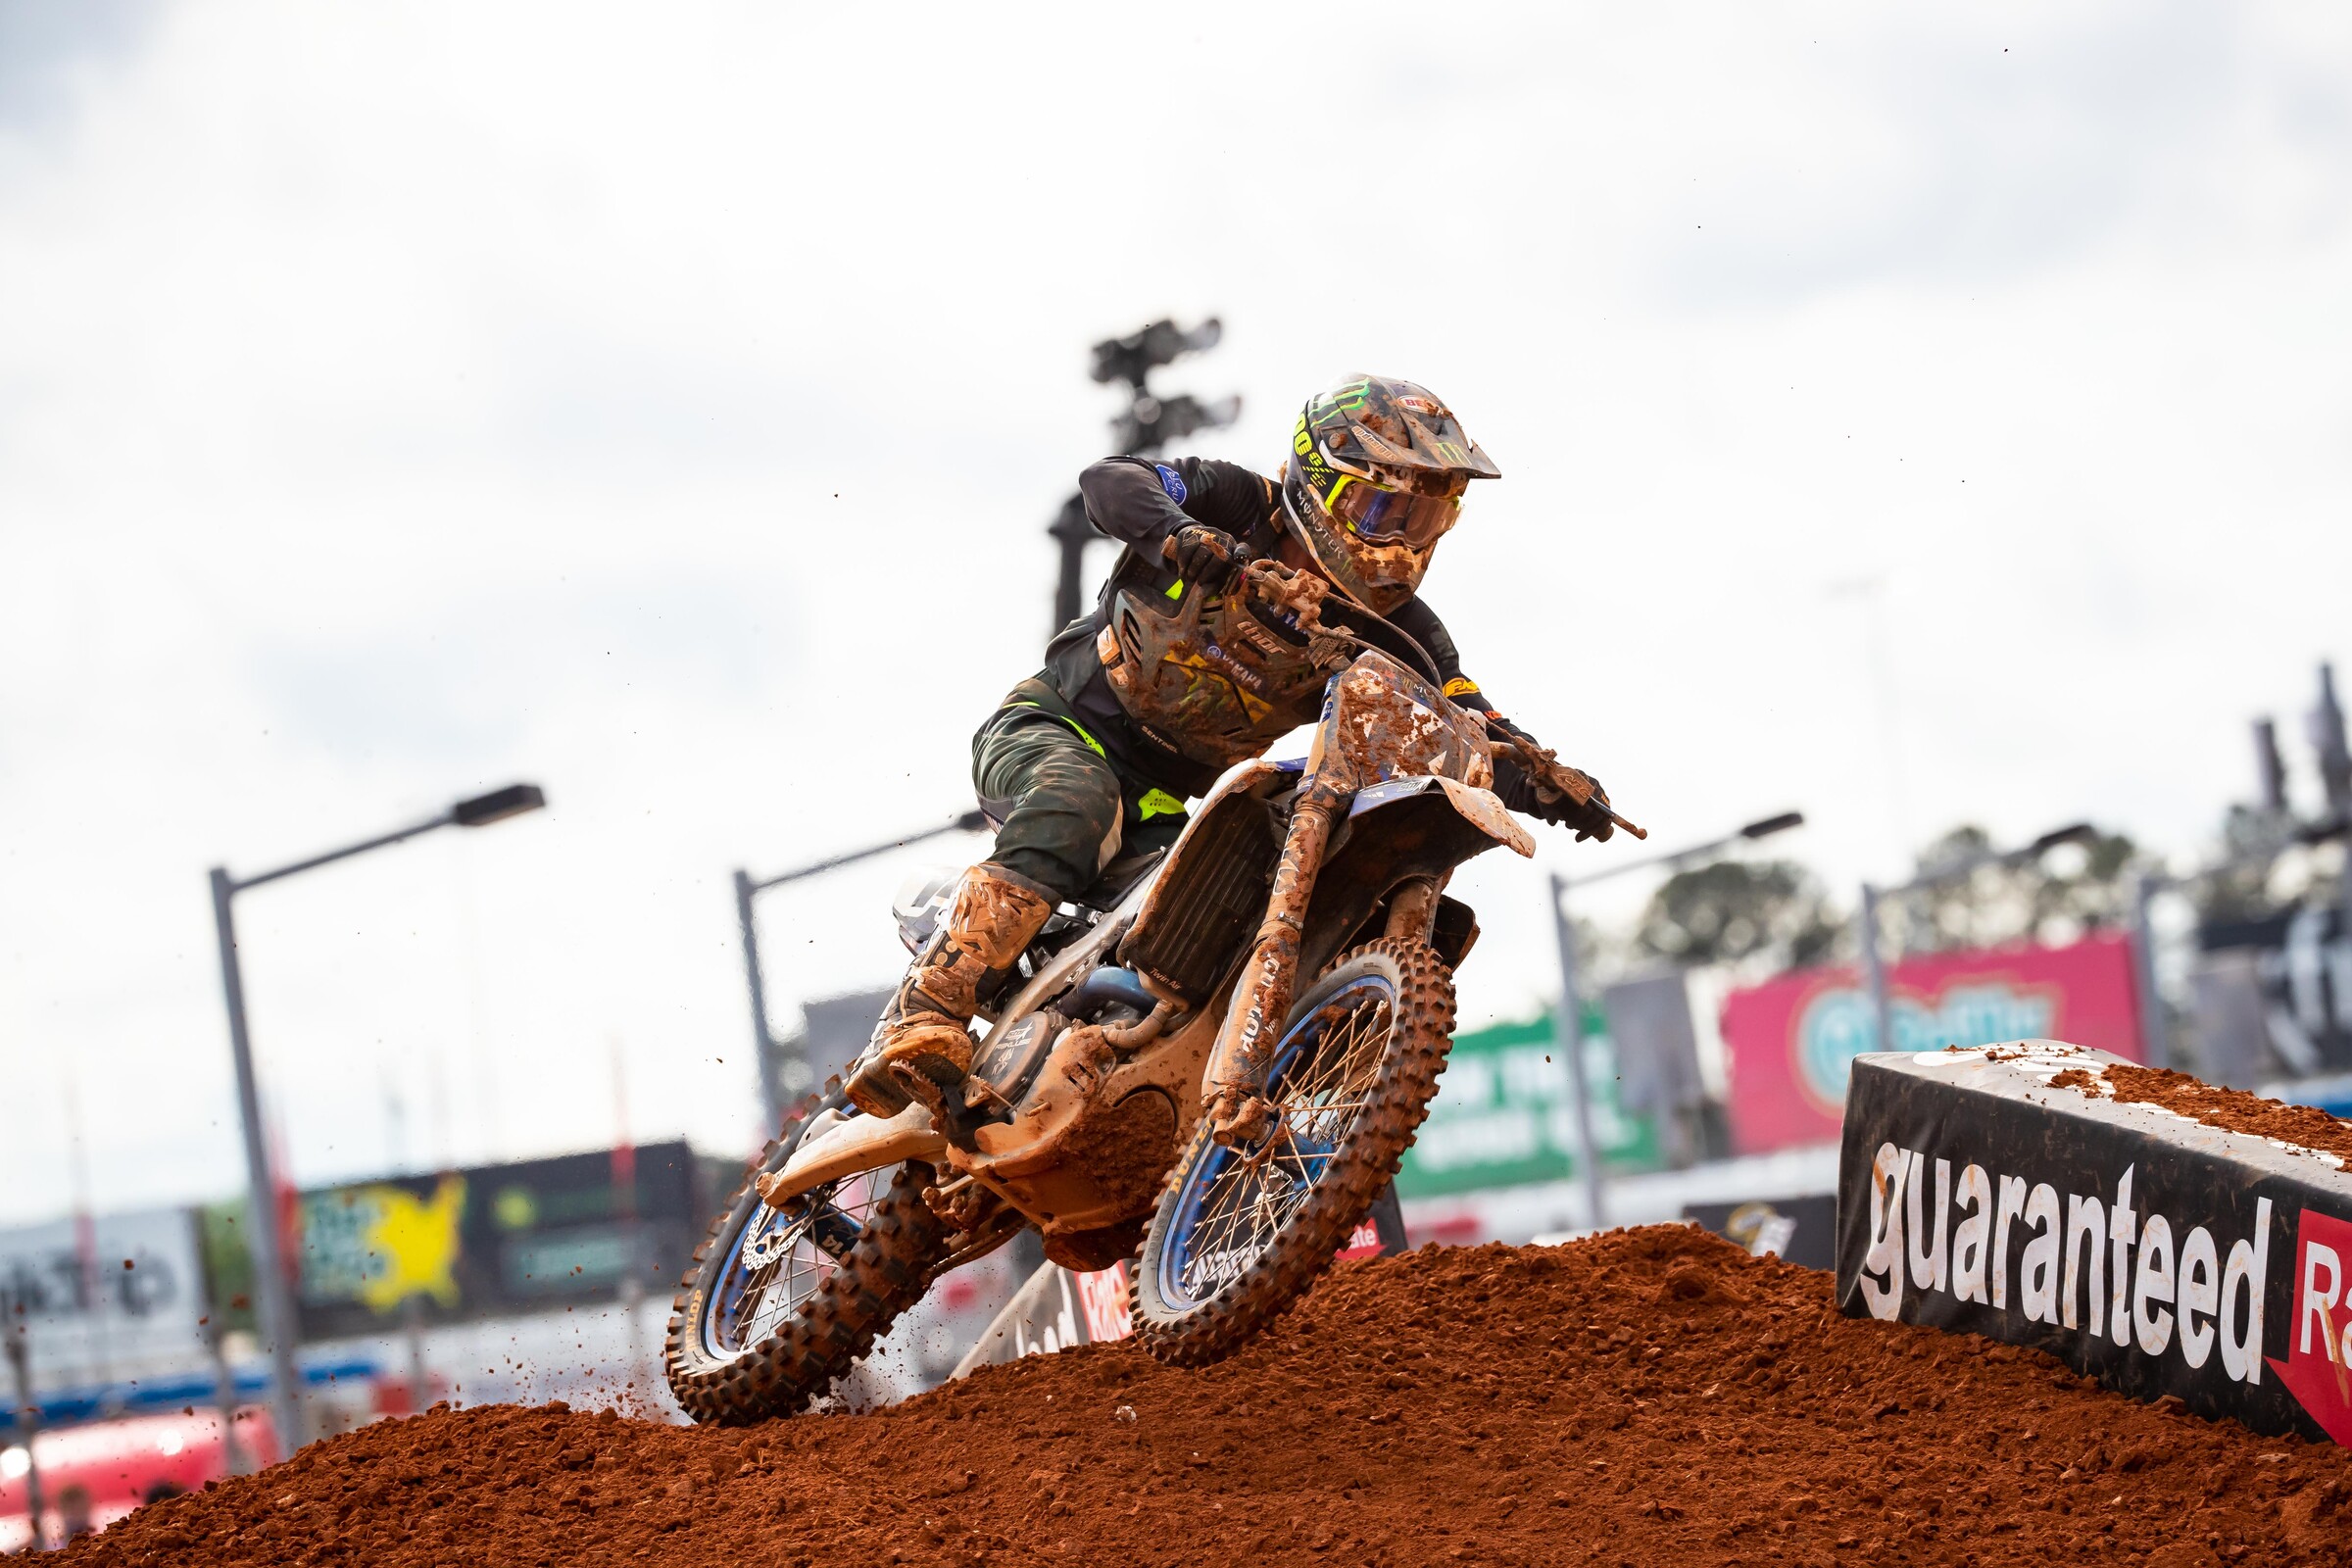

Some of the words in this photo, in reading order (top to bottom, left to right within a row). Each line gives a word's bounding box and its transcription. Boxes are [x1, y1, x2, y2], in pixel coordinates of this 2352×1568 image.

[1294, 413, 1334, 487] 00%
[1150, 966, 1169, 984] Twin
[1170, 1119, 1212, 1195] DUNL
[1348, 1224, 1378, 1250] ate
[1860, 1142, 2273, 1386] guaranteed
